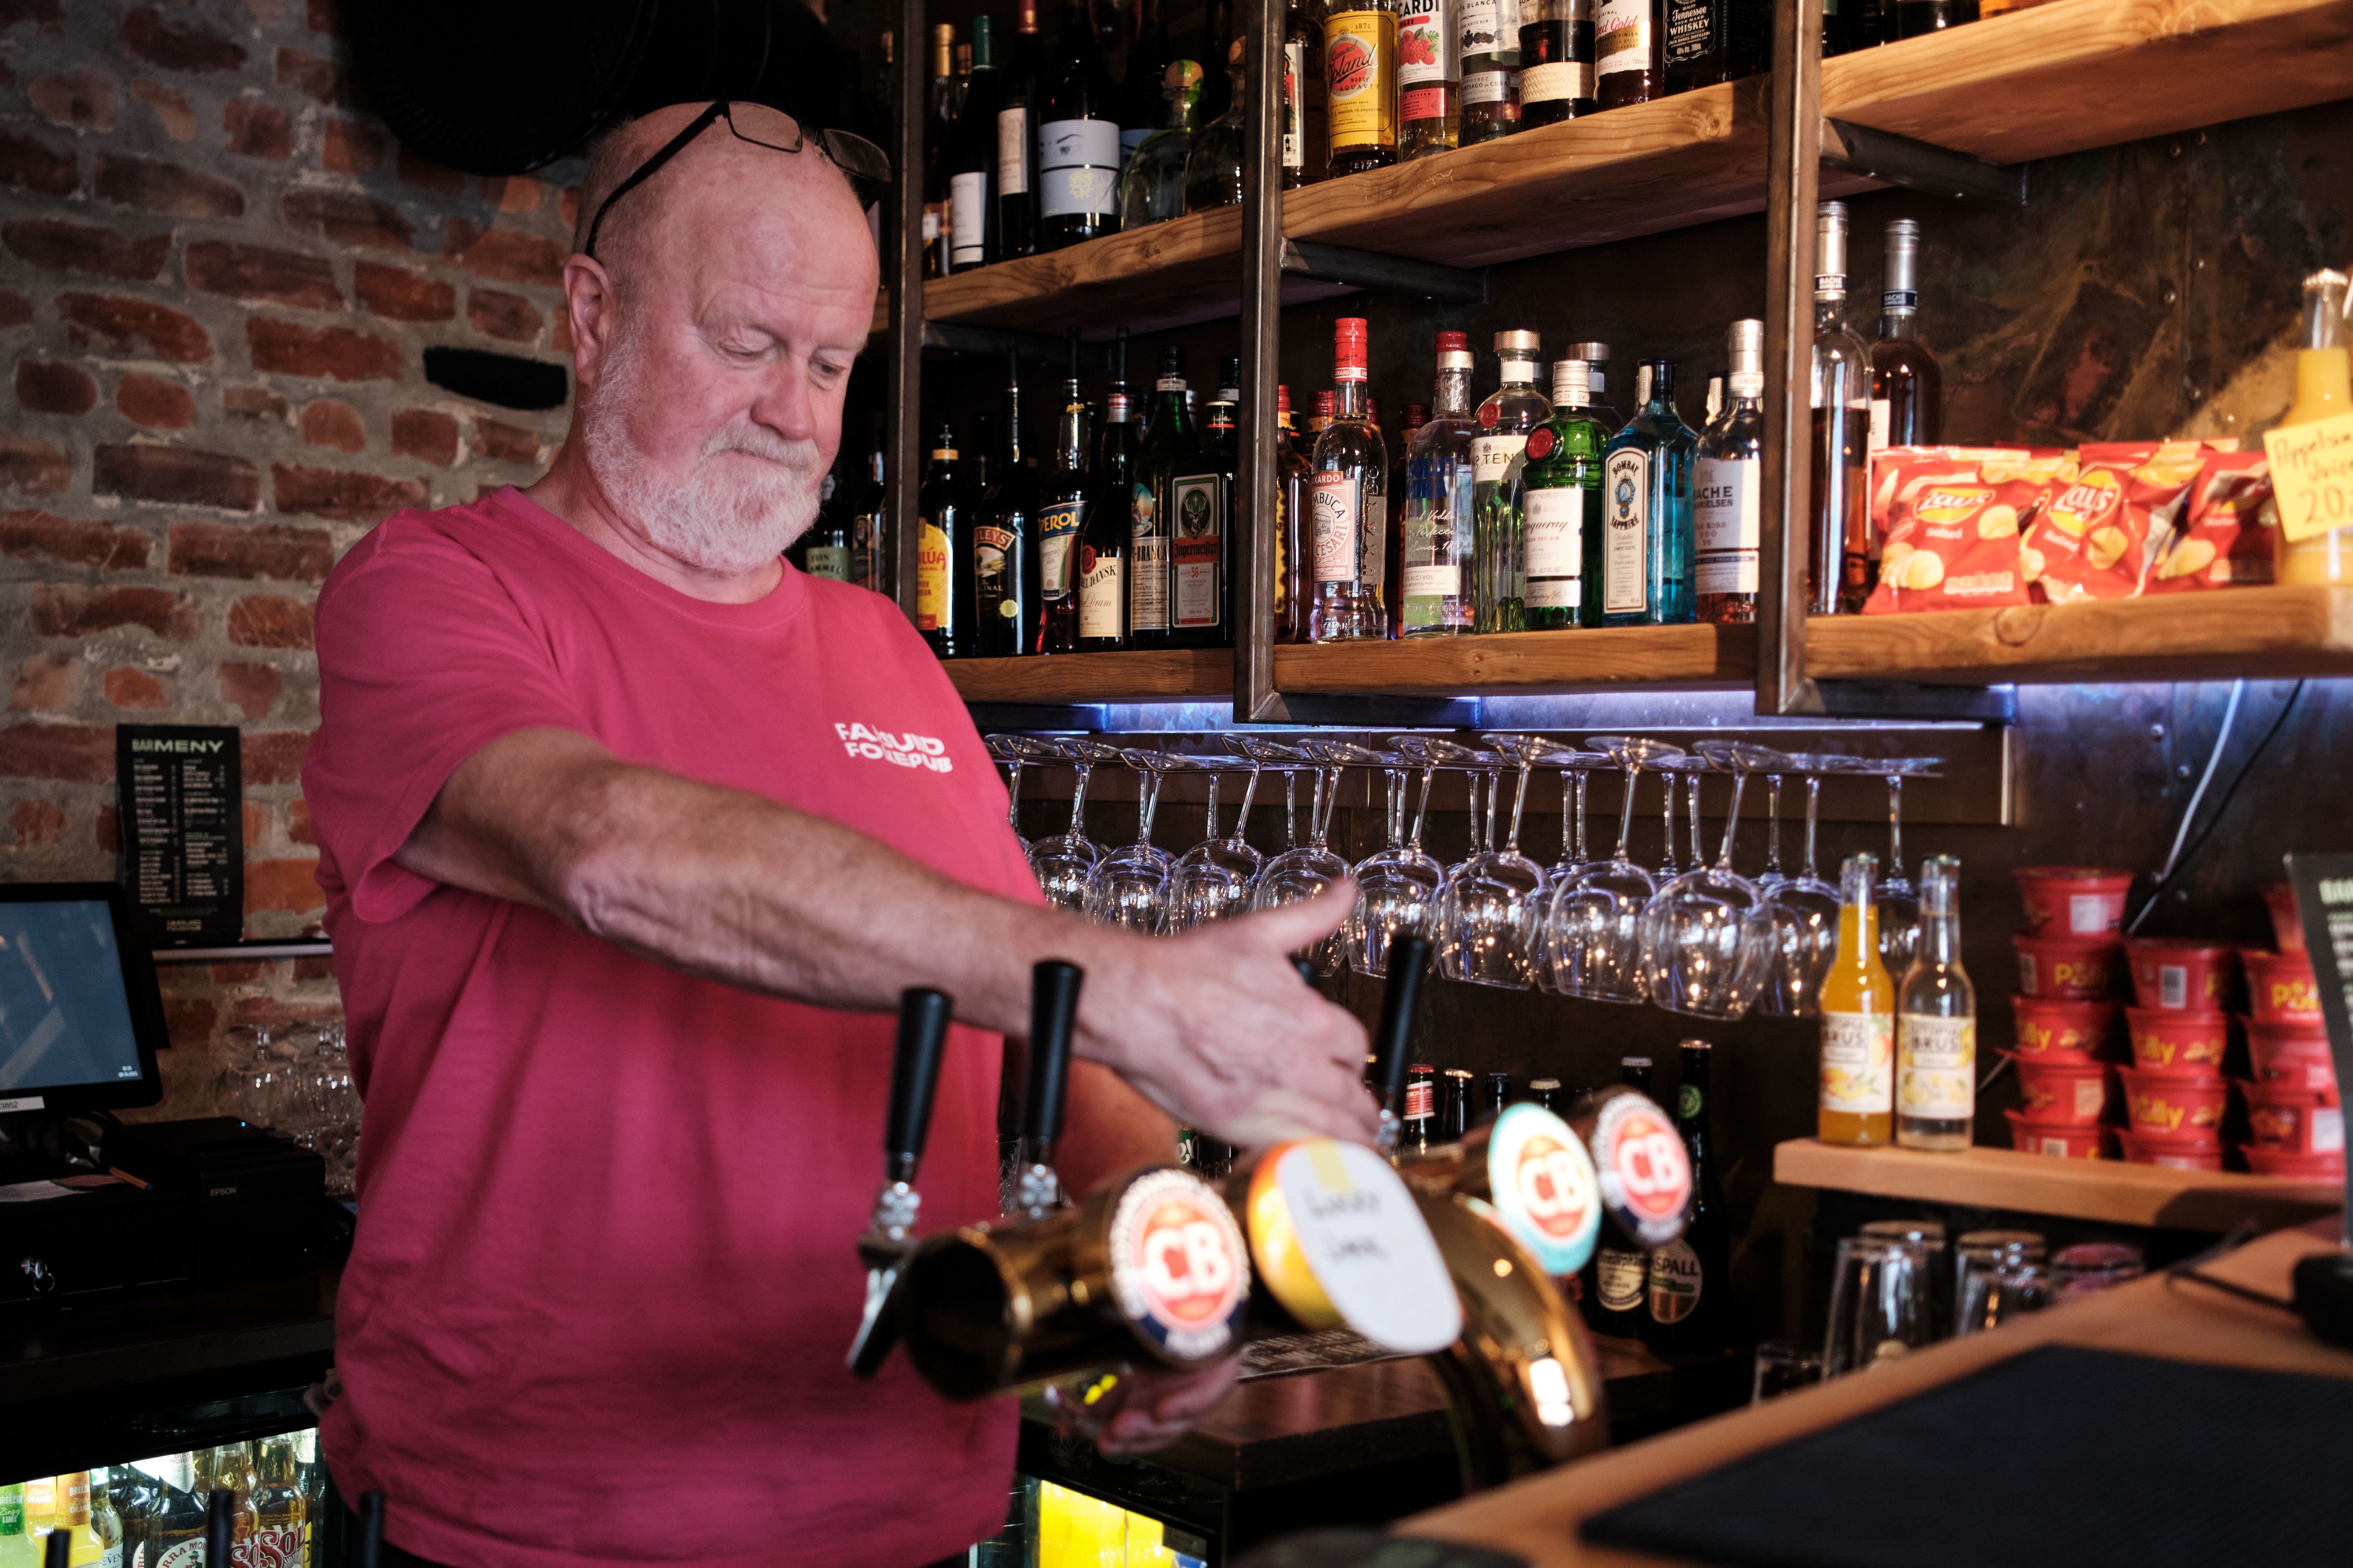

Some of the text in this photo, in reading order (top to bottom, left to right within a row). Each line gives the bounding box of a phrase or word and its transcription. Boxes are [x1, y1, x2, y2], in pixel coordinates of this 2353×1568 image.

[1467, 0, 1497, 9] BLANCA
[1672, 6, 1707, 22] Tennessee
[1610, 15, 1638, 31] Gold
[1669, 18, 1710, 36] WHISKEY
[1676, 47, 1684, 55] 40%
[1482, 453, 1515, 464] TEN
[1612, 460, 1640, 476] BOMBAY
[1918, 490, 1992, 512] Lay's
[2053, 484, 2116, 521] Lay's
[1610, 514, 1640, 530] SAPPHIRE
[1925, 528, 1963, 539] Salted
[2042, 530, 2079, 552] Salted
[1090, 565, 1117, 587] DANSK
[1191, 567, 1199, 578] 56
[1618, 1132, 1684, 1197] CB
[1519, 1149, 1586, 1215] CB
[211, 1186, 236, 1196] EPSON
[1143, 1220, 1234, 1297] CB
[1654, 1256, 1698, 1276] SPALL
[2, 1515, 18, 1523] LIME
